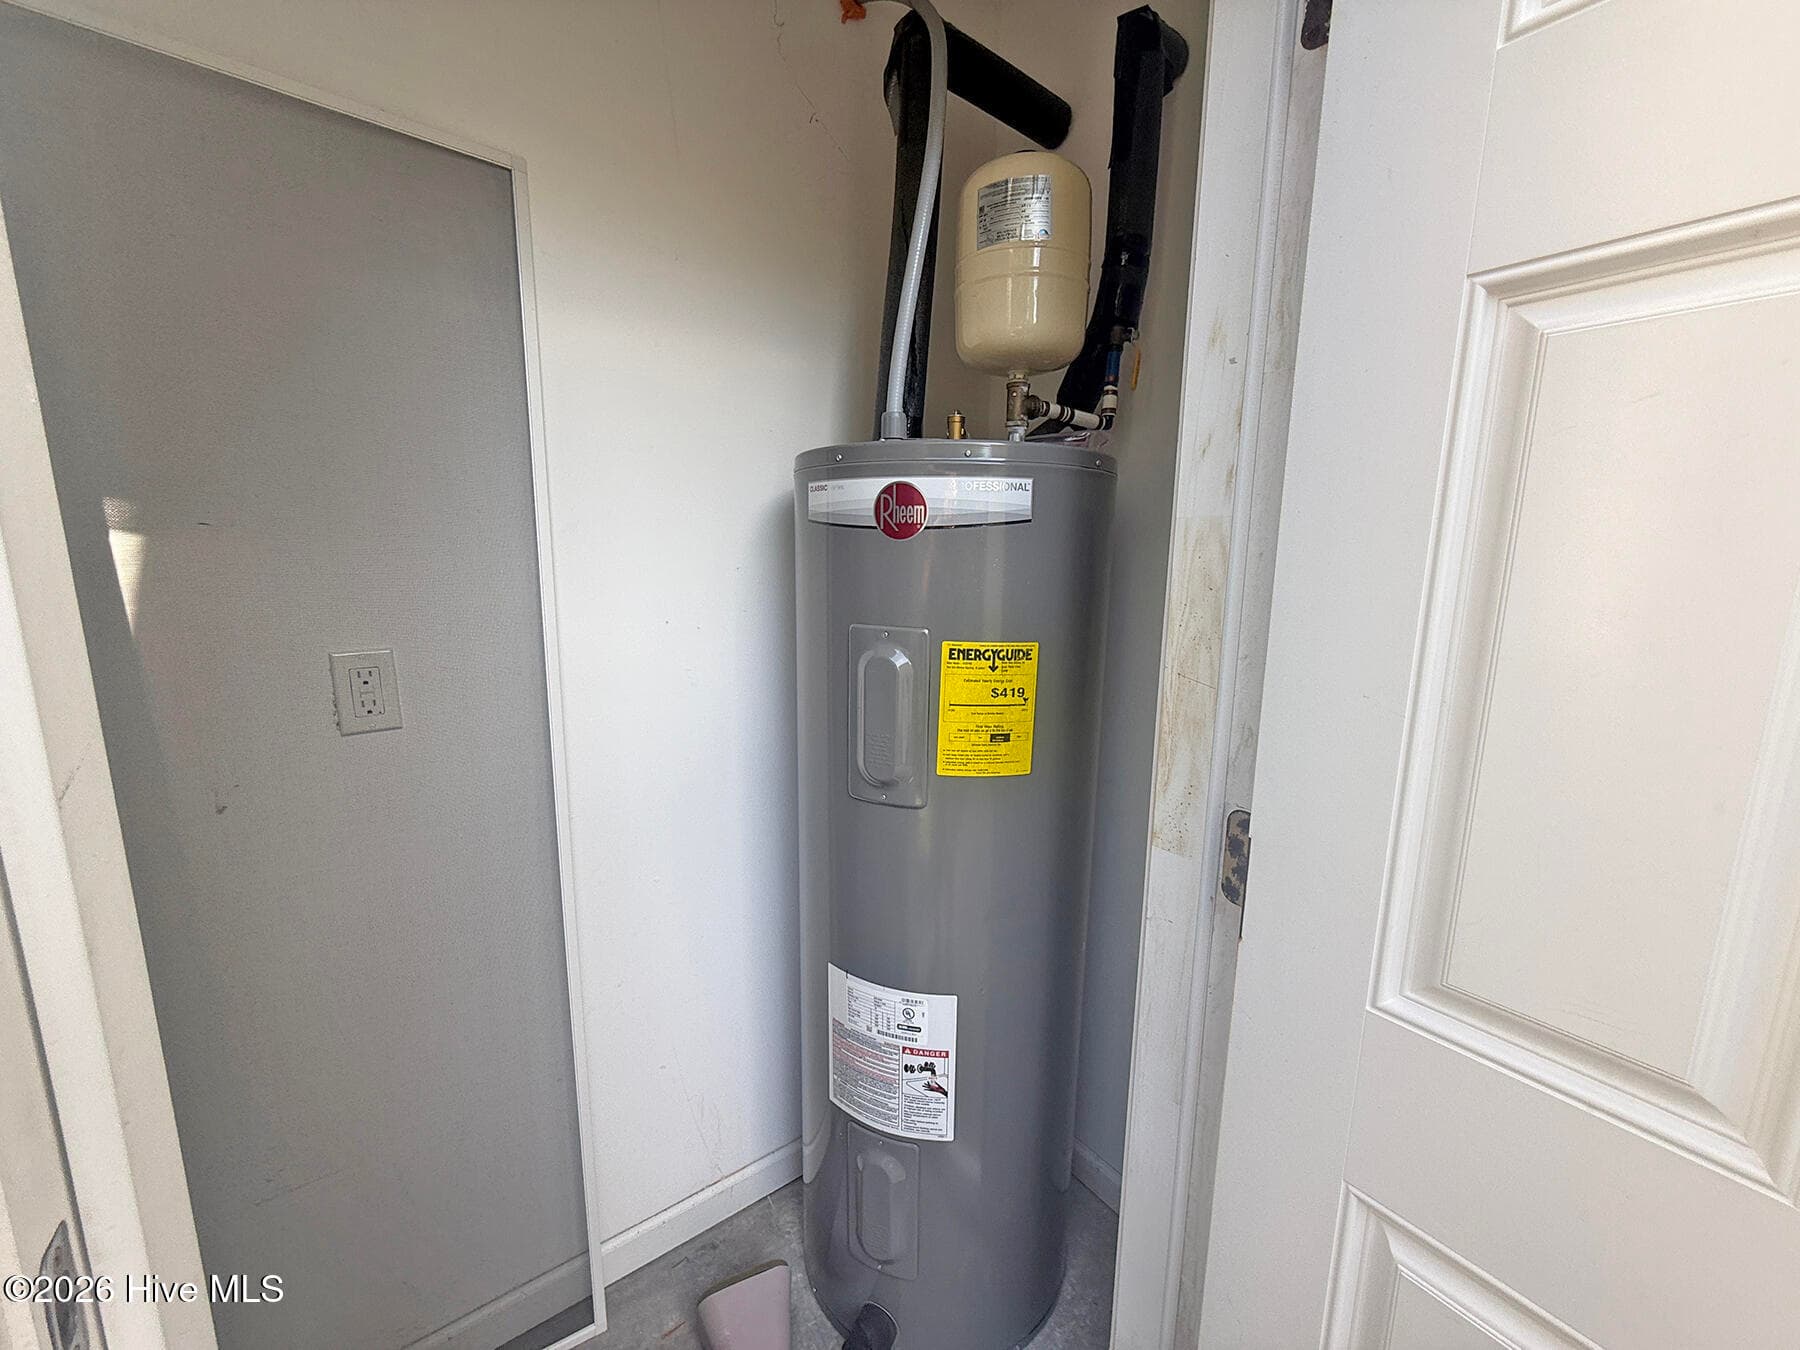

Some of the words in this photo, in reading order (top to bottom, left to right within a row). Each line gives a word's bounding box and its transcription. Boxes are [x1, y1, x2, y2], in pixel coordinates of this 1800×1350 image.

[809, 484, 828, 493] CLASSIC
[880, 483, 926, 532] Rheem
[948, 647, 1033, 661] ENERGYGUIDE
[912, 1047, 947, 1057] DANGER
